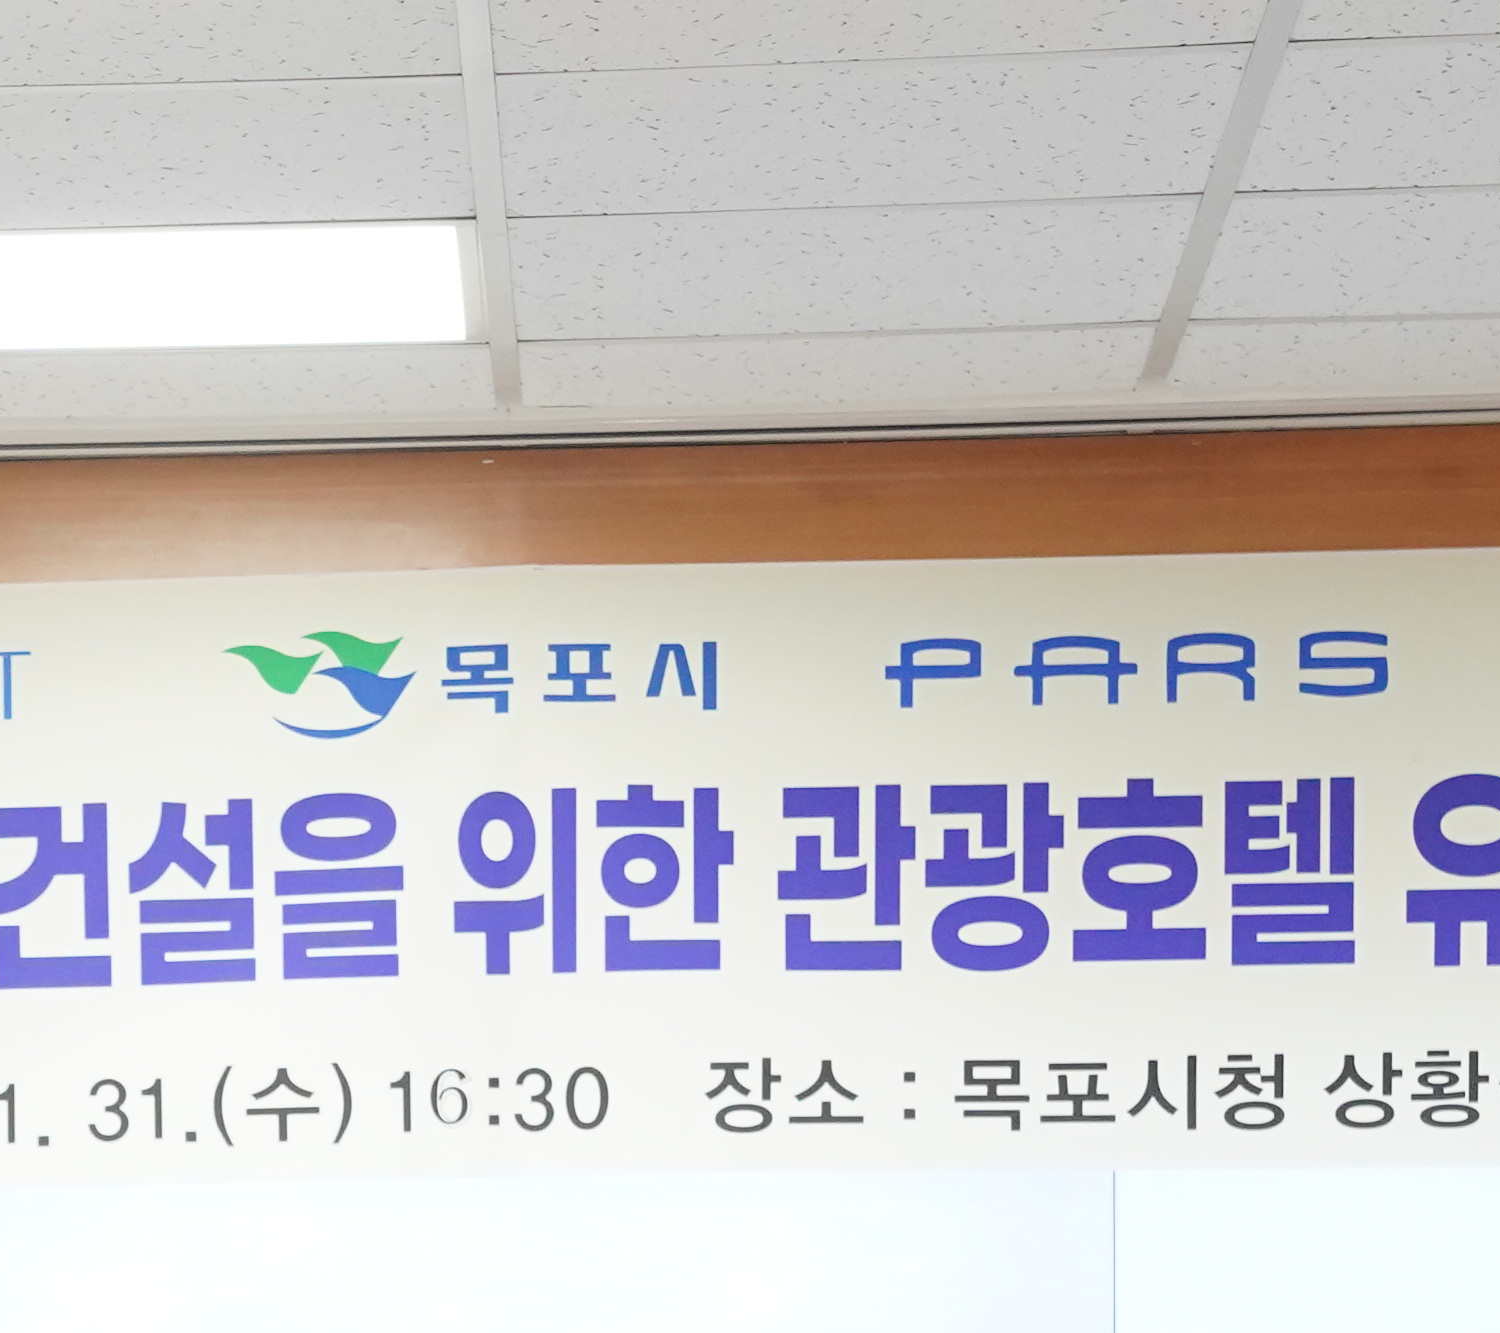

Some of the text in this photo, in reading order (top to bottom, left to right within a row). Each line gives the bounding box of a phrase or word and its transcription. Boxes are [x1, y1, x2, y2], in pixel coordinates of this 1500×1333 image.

[441, 641, 717, 714] 목포시
[885, 631, 1389, 708] PARS
[454, 784, 735, 975] 위한
[777, 776, 1356, 972] 관광호텔
[87, 1062, 353, 1146] 31.(수)
[390, 1066, 609, 1132] 16:30
[705, 1057, 864, 1133] 장소
[954, 1053, 1285, 1131] 목포시청
